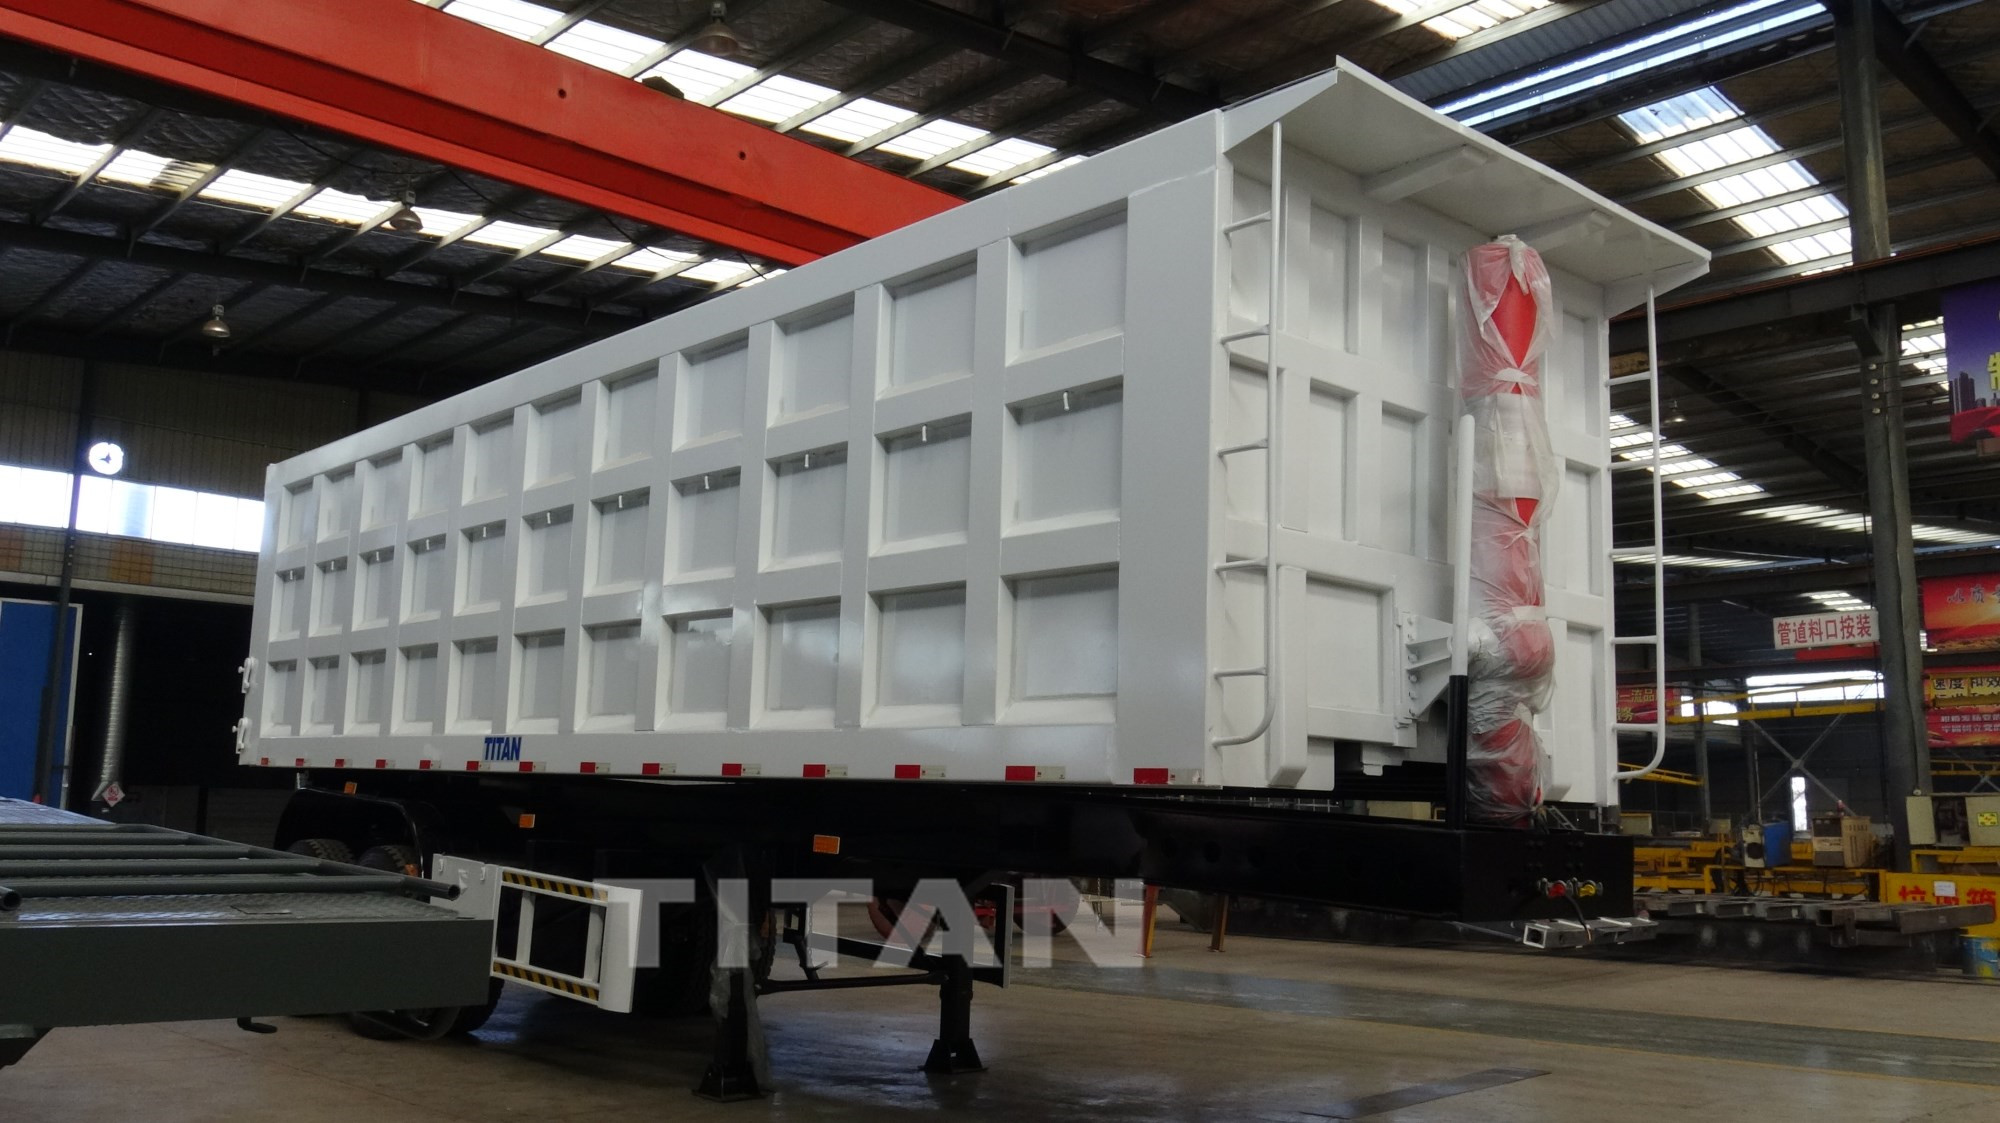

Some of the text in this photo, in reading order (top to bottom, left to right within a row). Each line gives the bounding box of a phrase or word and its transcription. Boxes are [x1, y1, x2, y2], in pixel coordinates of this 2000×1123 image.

[1777, 614, 1872, 645] 管道料口按装
[484, 736, 522, 761] TITAN
